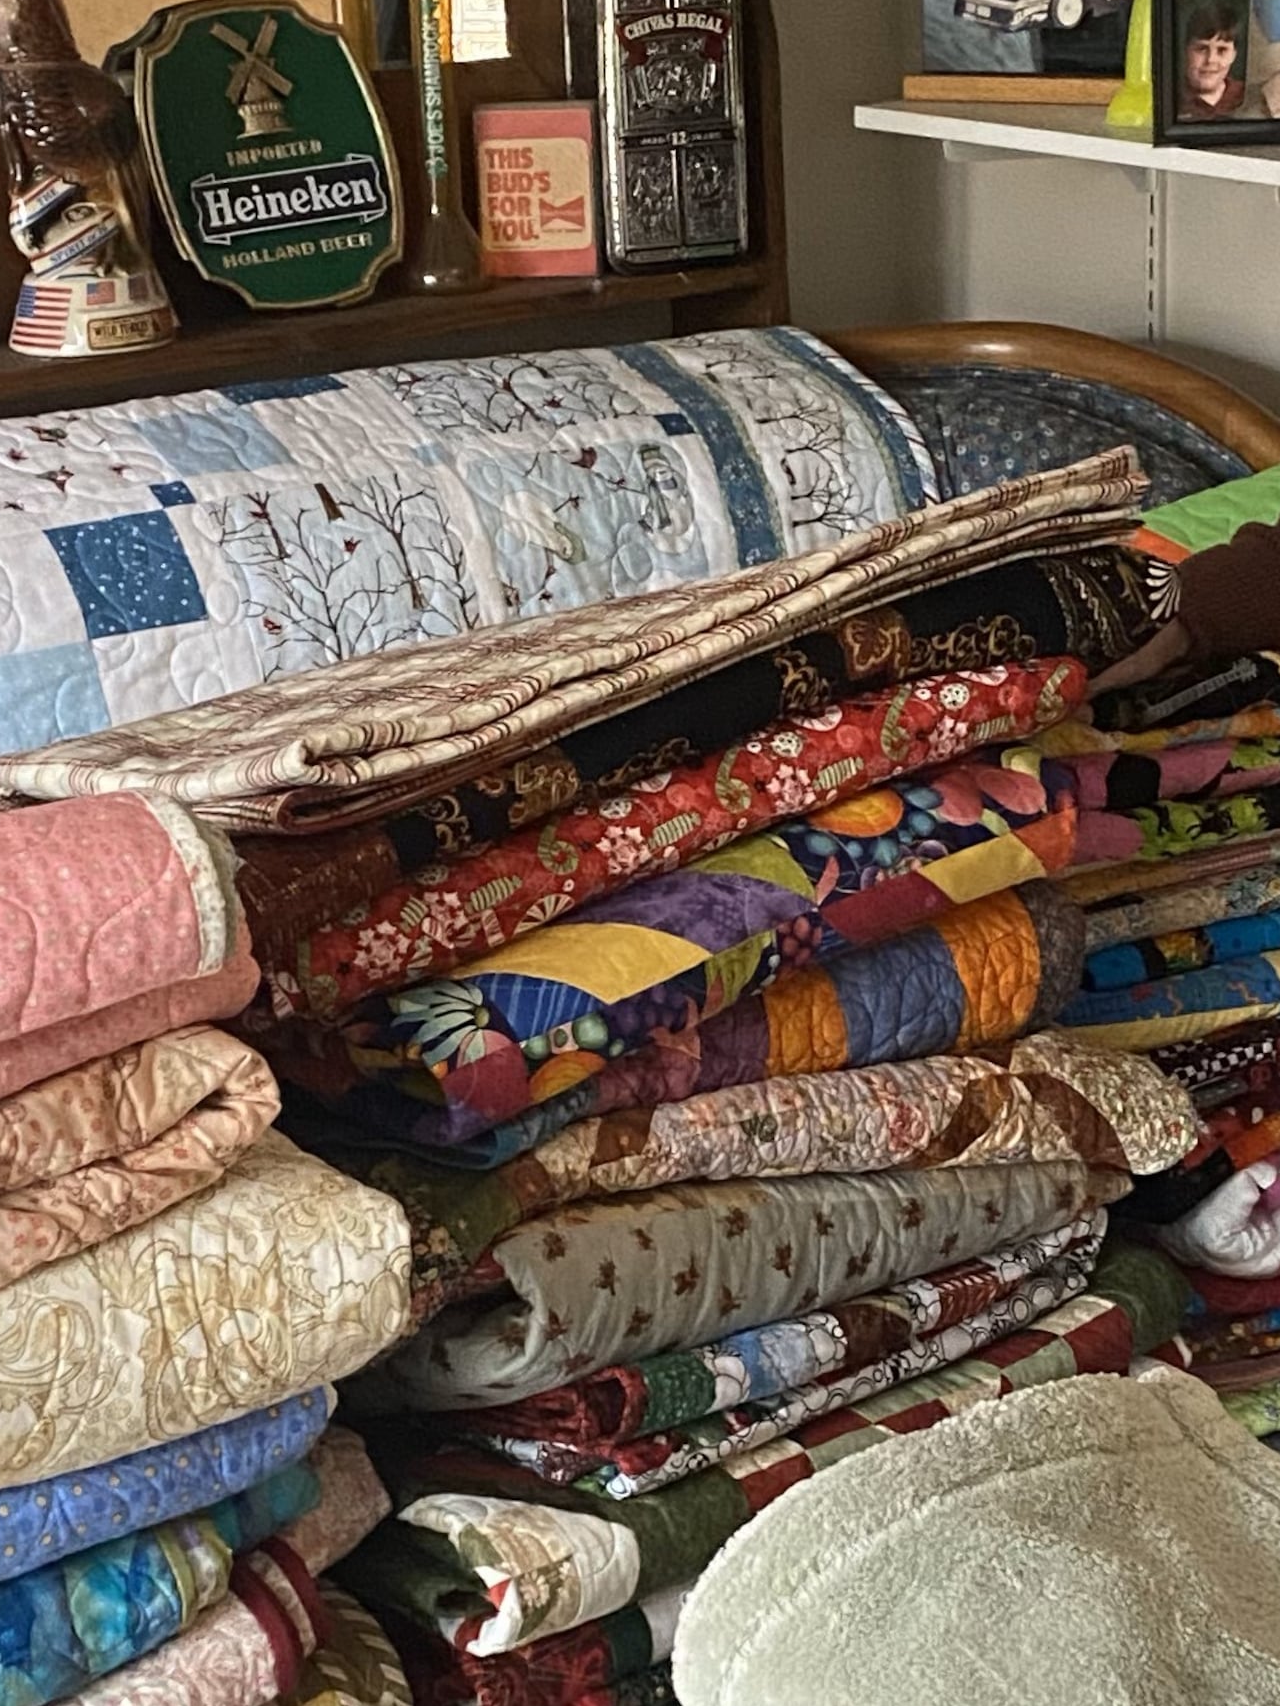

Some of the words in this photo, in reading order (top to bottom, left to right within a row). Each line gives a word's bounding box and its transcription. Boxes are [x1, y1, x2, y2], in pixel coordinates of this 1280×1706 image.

[624, 12, 675, 40] CHIVAS
[676, 12, 724, 34] REGAL
[422, 18, 442, 108] SHAMROCK
[671, 130, 687, 146] 12
[226, 139, 323, 168] IMPORTED
[485, 147, 534, 169] THIS
[487, 171, 551, 194] BUD'S
[203, 175, 377, 228] Heineken
[487, 196, 532, 217] FOR
[488, 219, 540, 242] YOU.
[222, 242, 316, 269] HOLLAND
[320, 232, 373, 253] BEER
